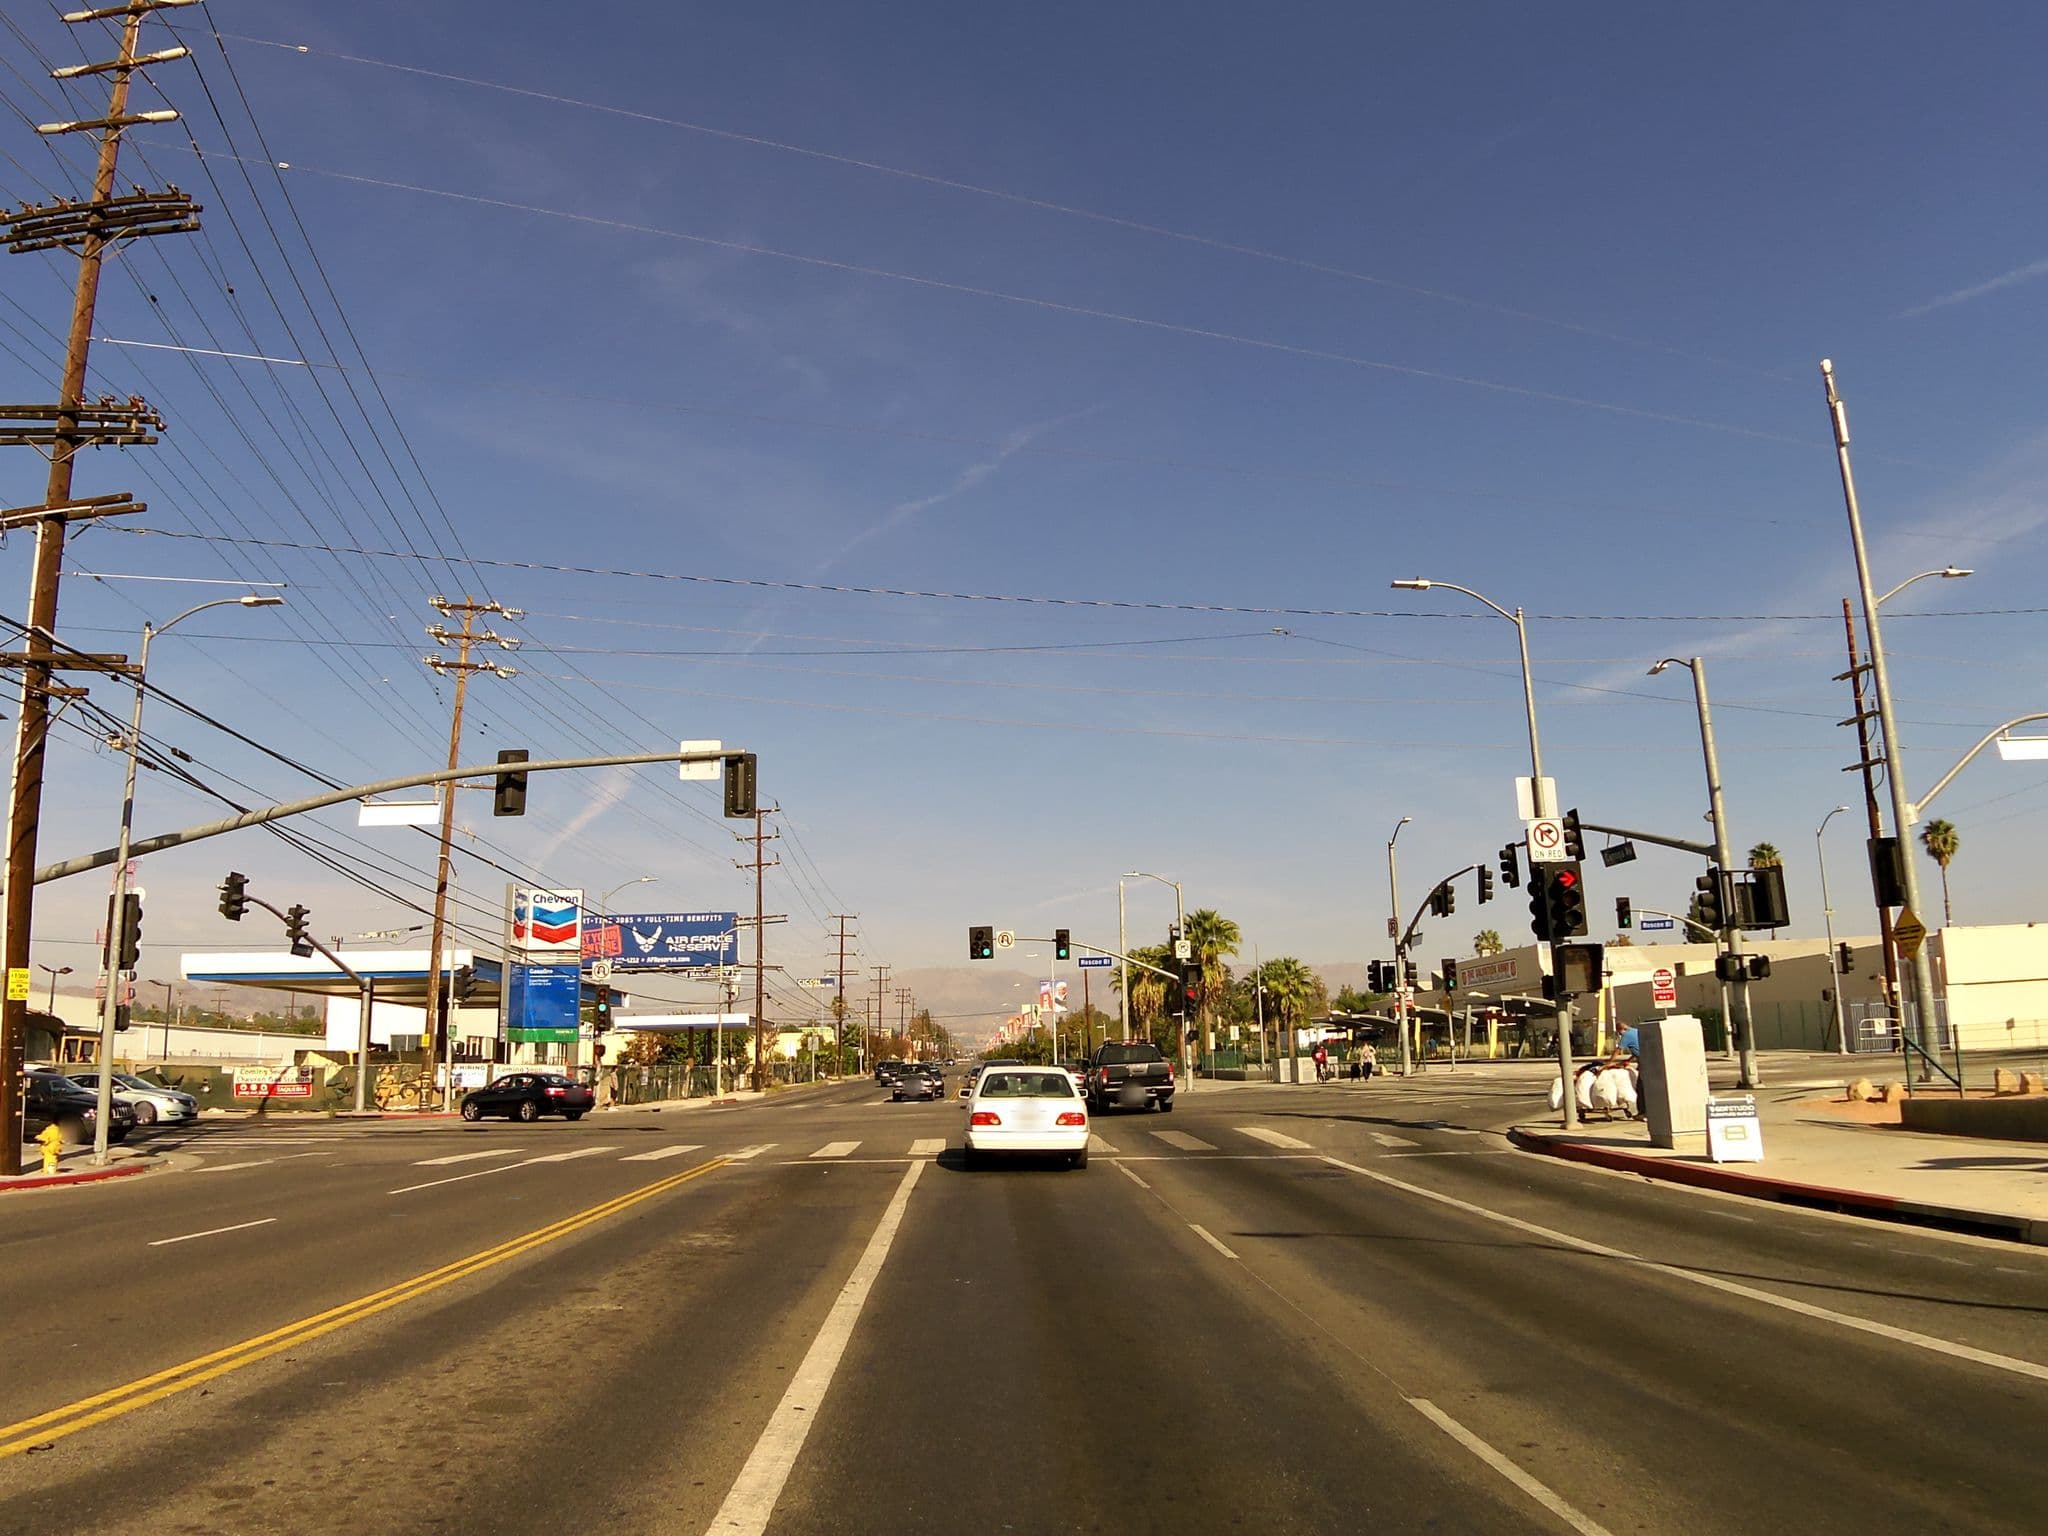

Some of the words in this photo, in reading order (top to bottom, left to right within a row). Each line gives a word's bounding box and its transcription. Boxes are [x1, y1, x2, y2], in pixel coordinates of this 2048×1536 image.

[1534, 850, 1545, 858] ON
[1547, 849, 1562, 857] RED
[533, 894, 579, 903] Chevron
[687, 914, 723, 922] BENEFITS
[665, 936, 689, 944] AIR
[690, 934, 734, 943] FORCE
[669, 943, 730, 952] RESERVE
